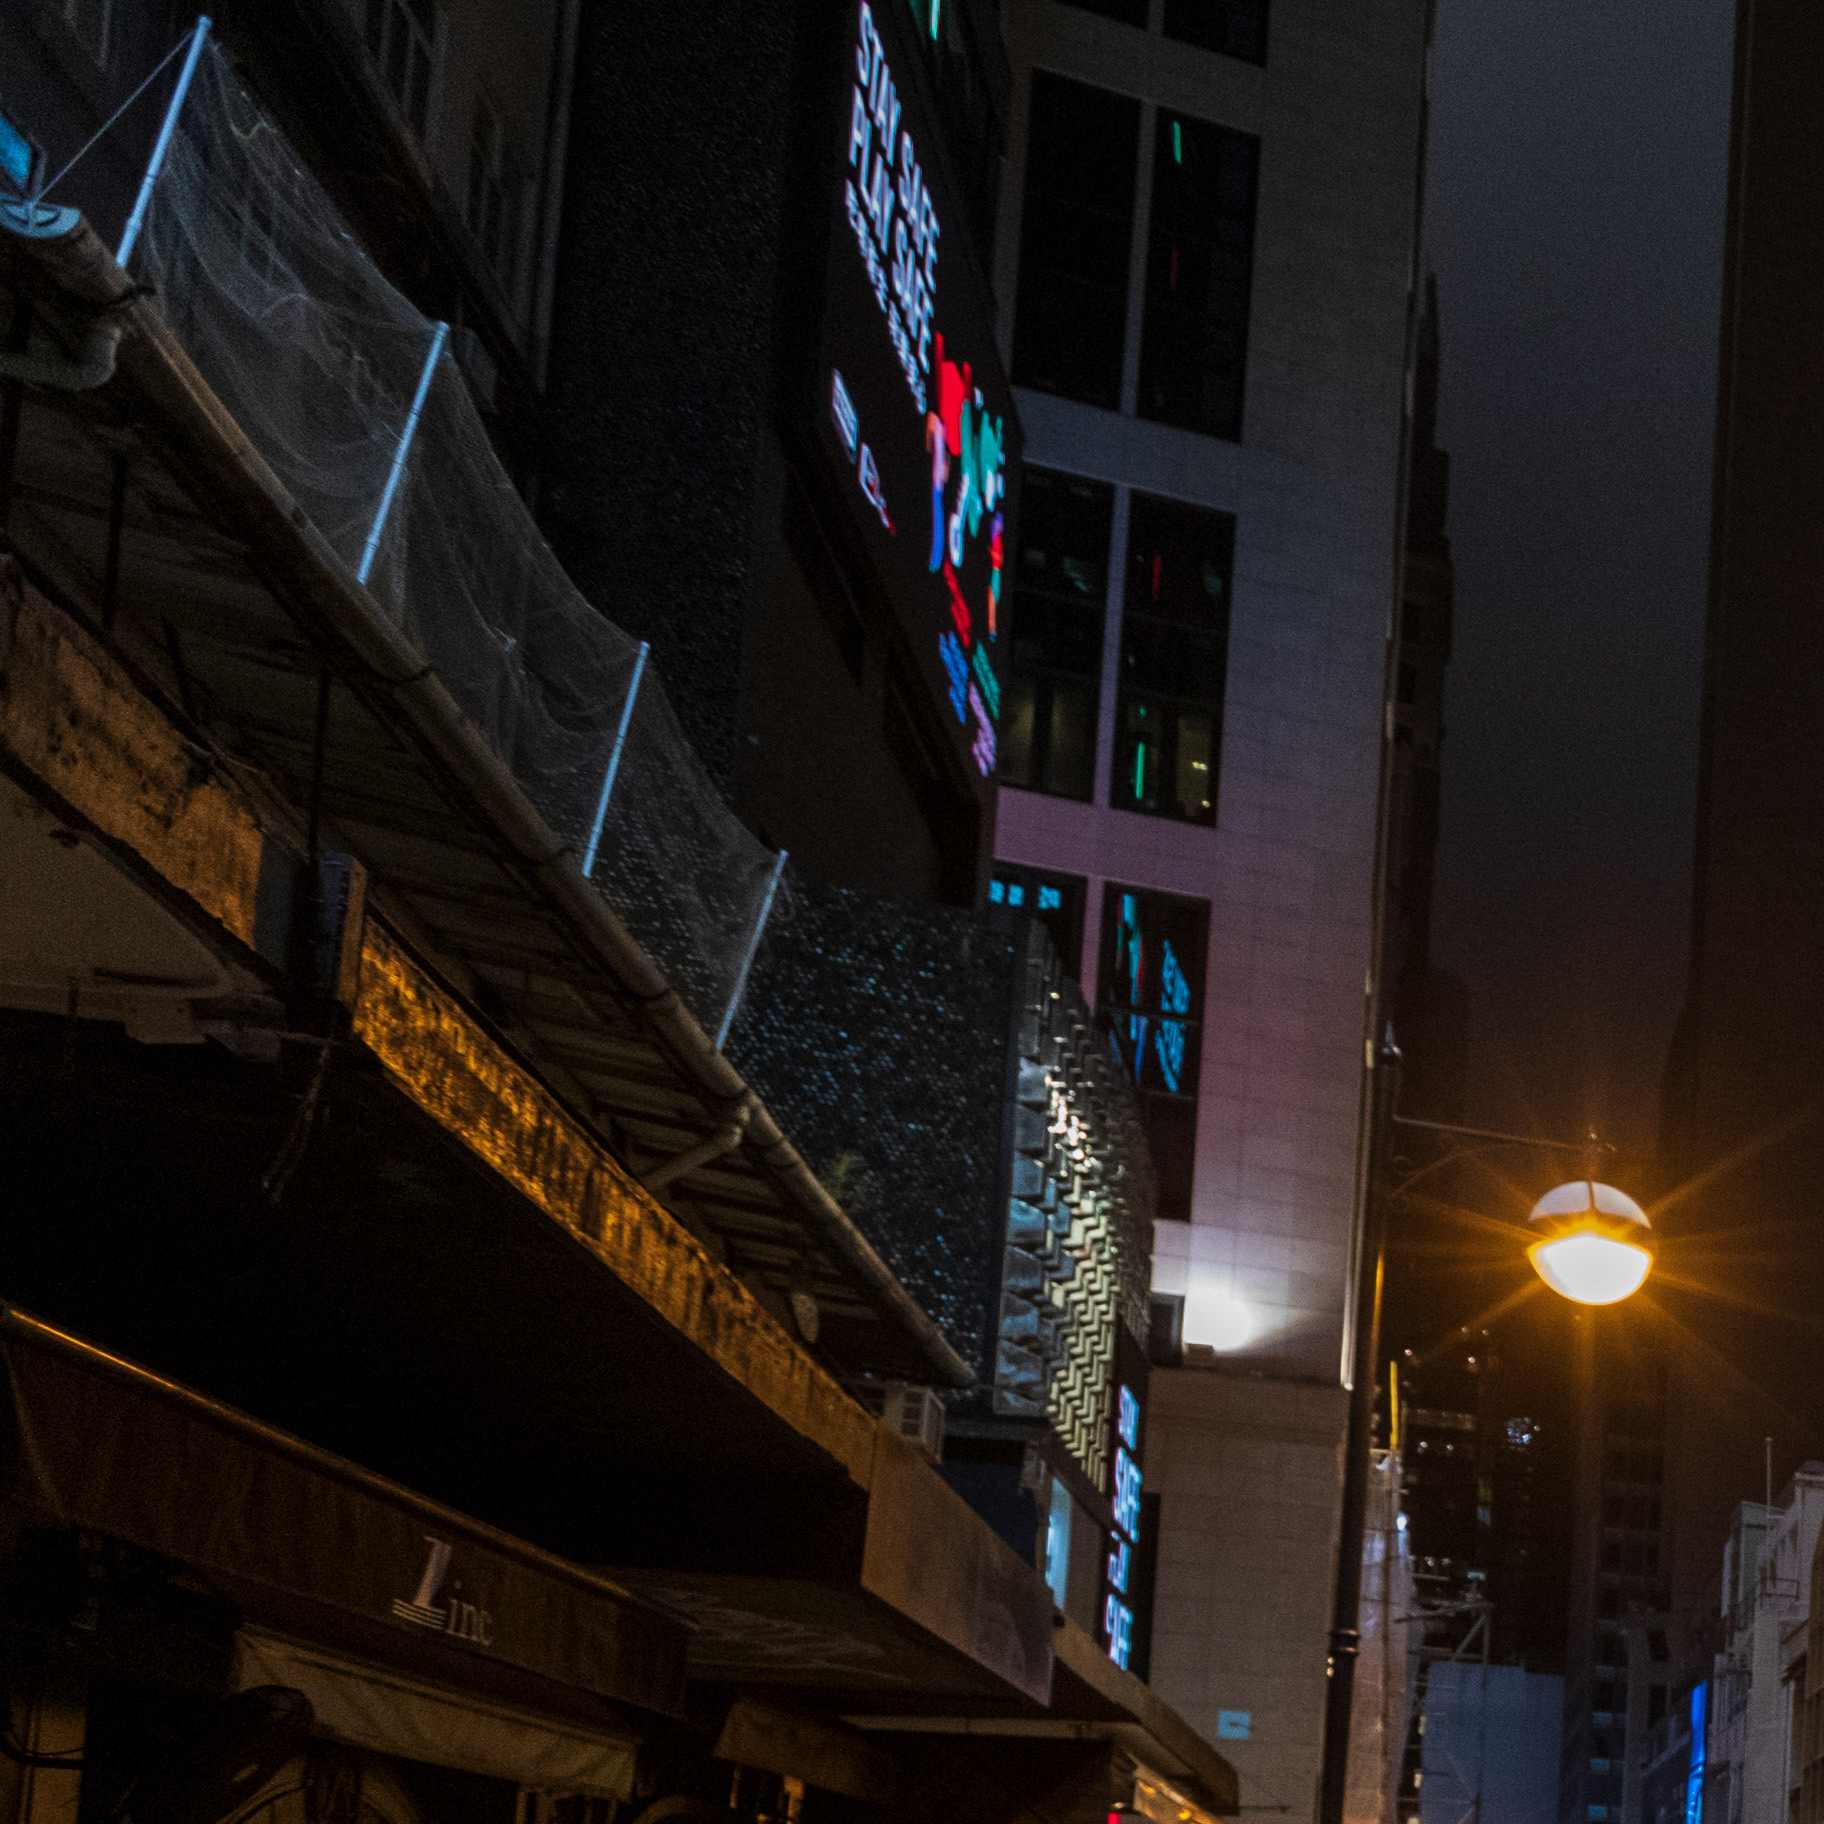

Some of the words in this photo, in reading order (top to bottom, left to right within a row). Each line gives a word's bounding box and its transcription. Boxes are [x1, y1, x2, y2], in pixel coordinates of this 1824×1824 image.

[849, 84, 896, 255] PLAY
[891, 218, 936, 375] SAFE
[857, 0, 902, 168] STAY
[899, 130, 941, 292] SAFE
